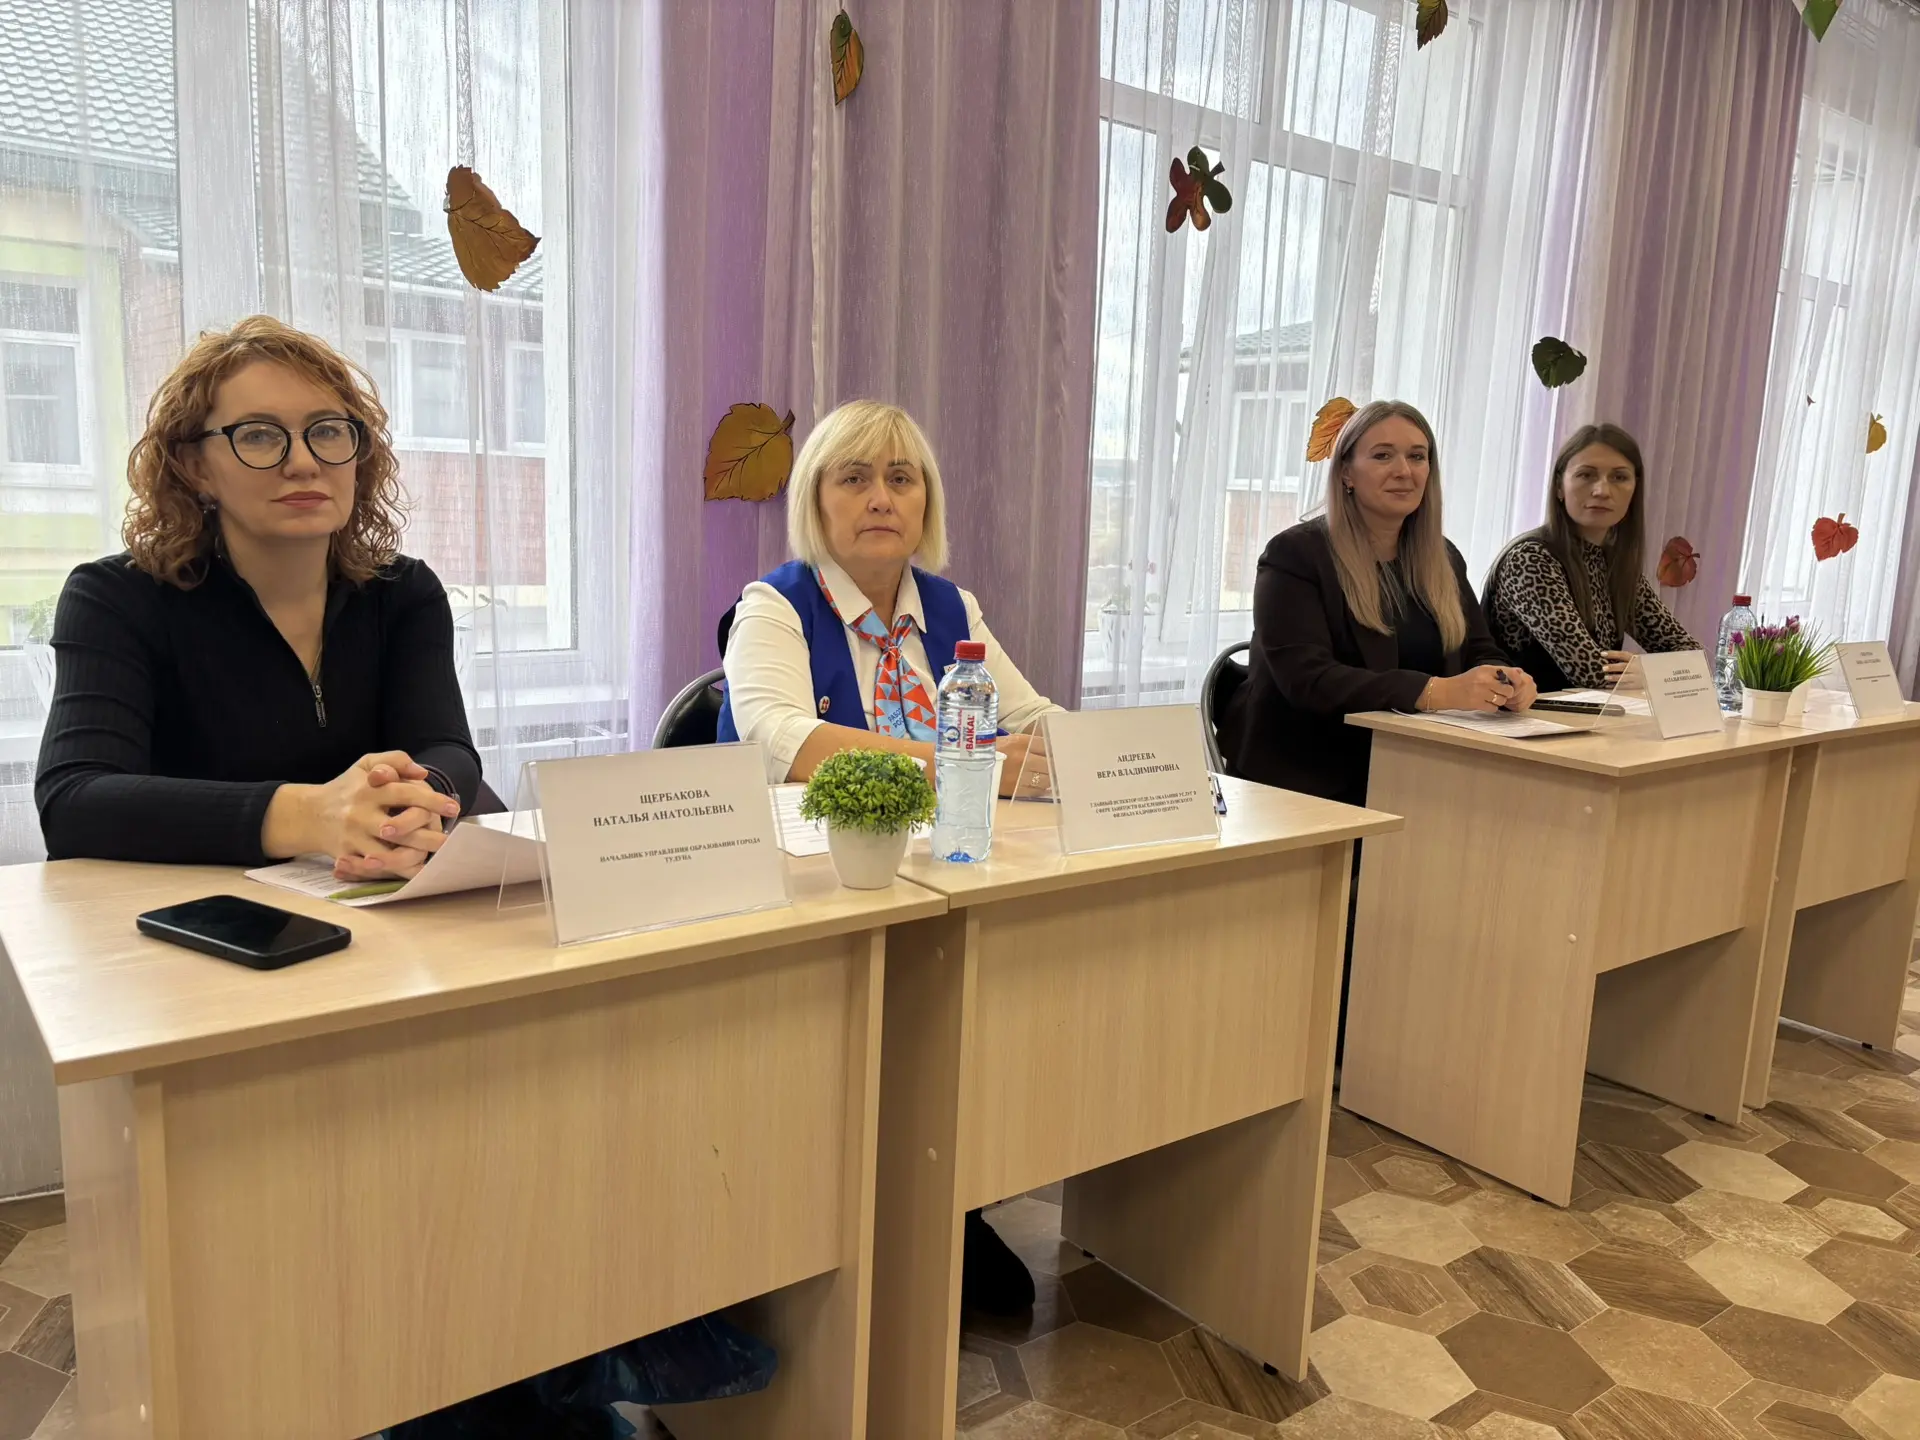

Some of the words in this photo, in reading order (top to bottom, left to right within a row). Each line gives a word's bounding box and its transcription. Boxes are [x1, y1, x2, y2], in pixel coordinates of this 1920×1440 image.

[966, 716, 974, 750] BAIKAL
[1118, 752, 1156, 762] АНДРЕЕВА
[1097, 769, 1116, 779] ВЕРА
[1118, 764, 1180, 777] ВЛАДИМИРОВНА
[640, 789, 710, 804] ЩЕРБАКОВА
[594, 812, 650, 827] НАТАЛЬЯ
[652, 804, 734, 821] АНАТОЛЬЕВНА
[600, 852, 644, 862] НАЧАЛЬНИК
[644, 846, 688, 857] УПРАВЛЕНИЯ
[690, 841, 736, 852] ОБРАЗОВАНИЯ
[736, 837, 760, 846] ГОРОДА
[664, 854, 692, 864] ТУЛУНА
